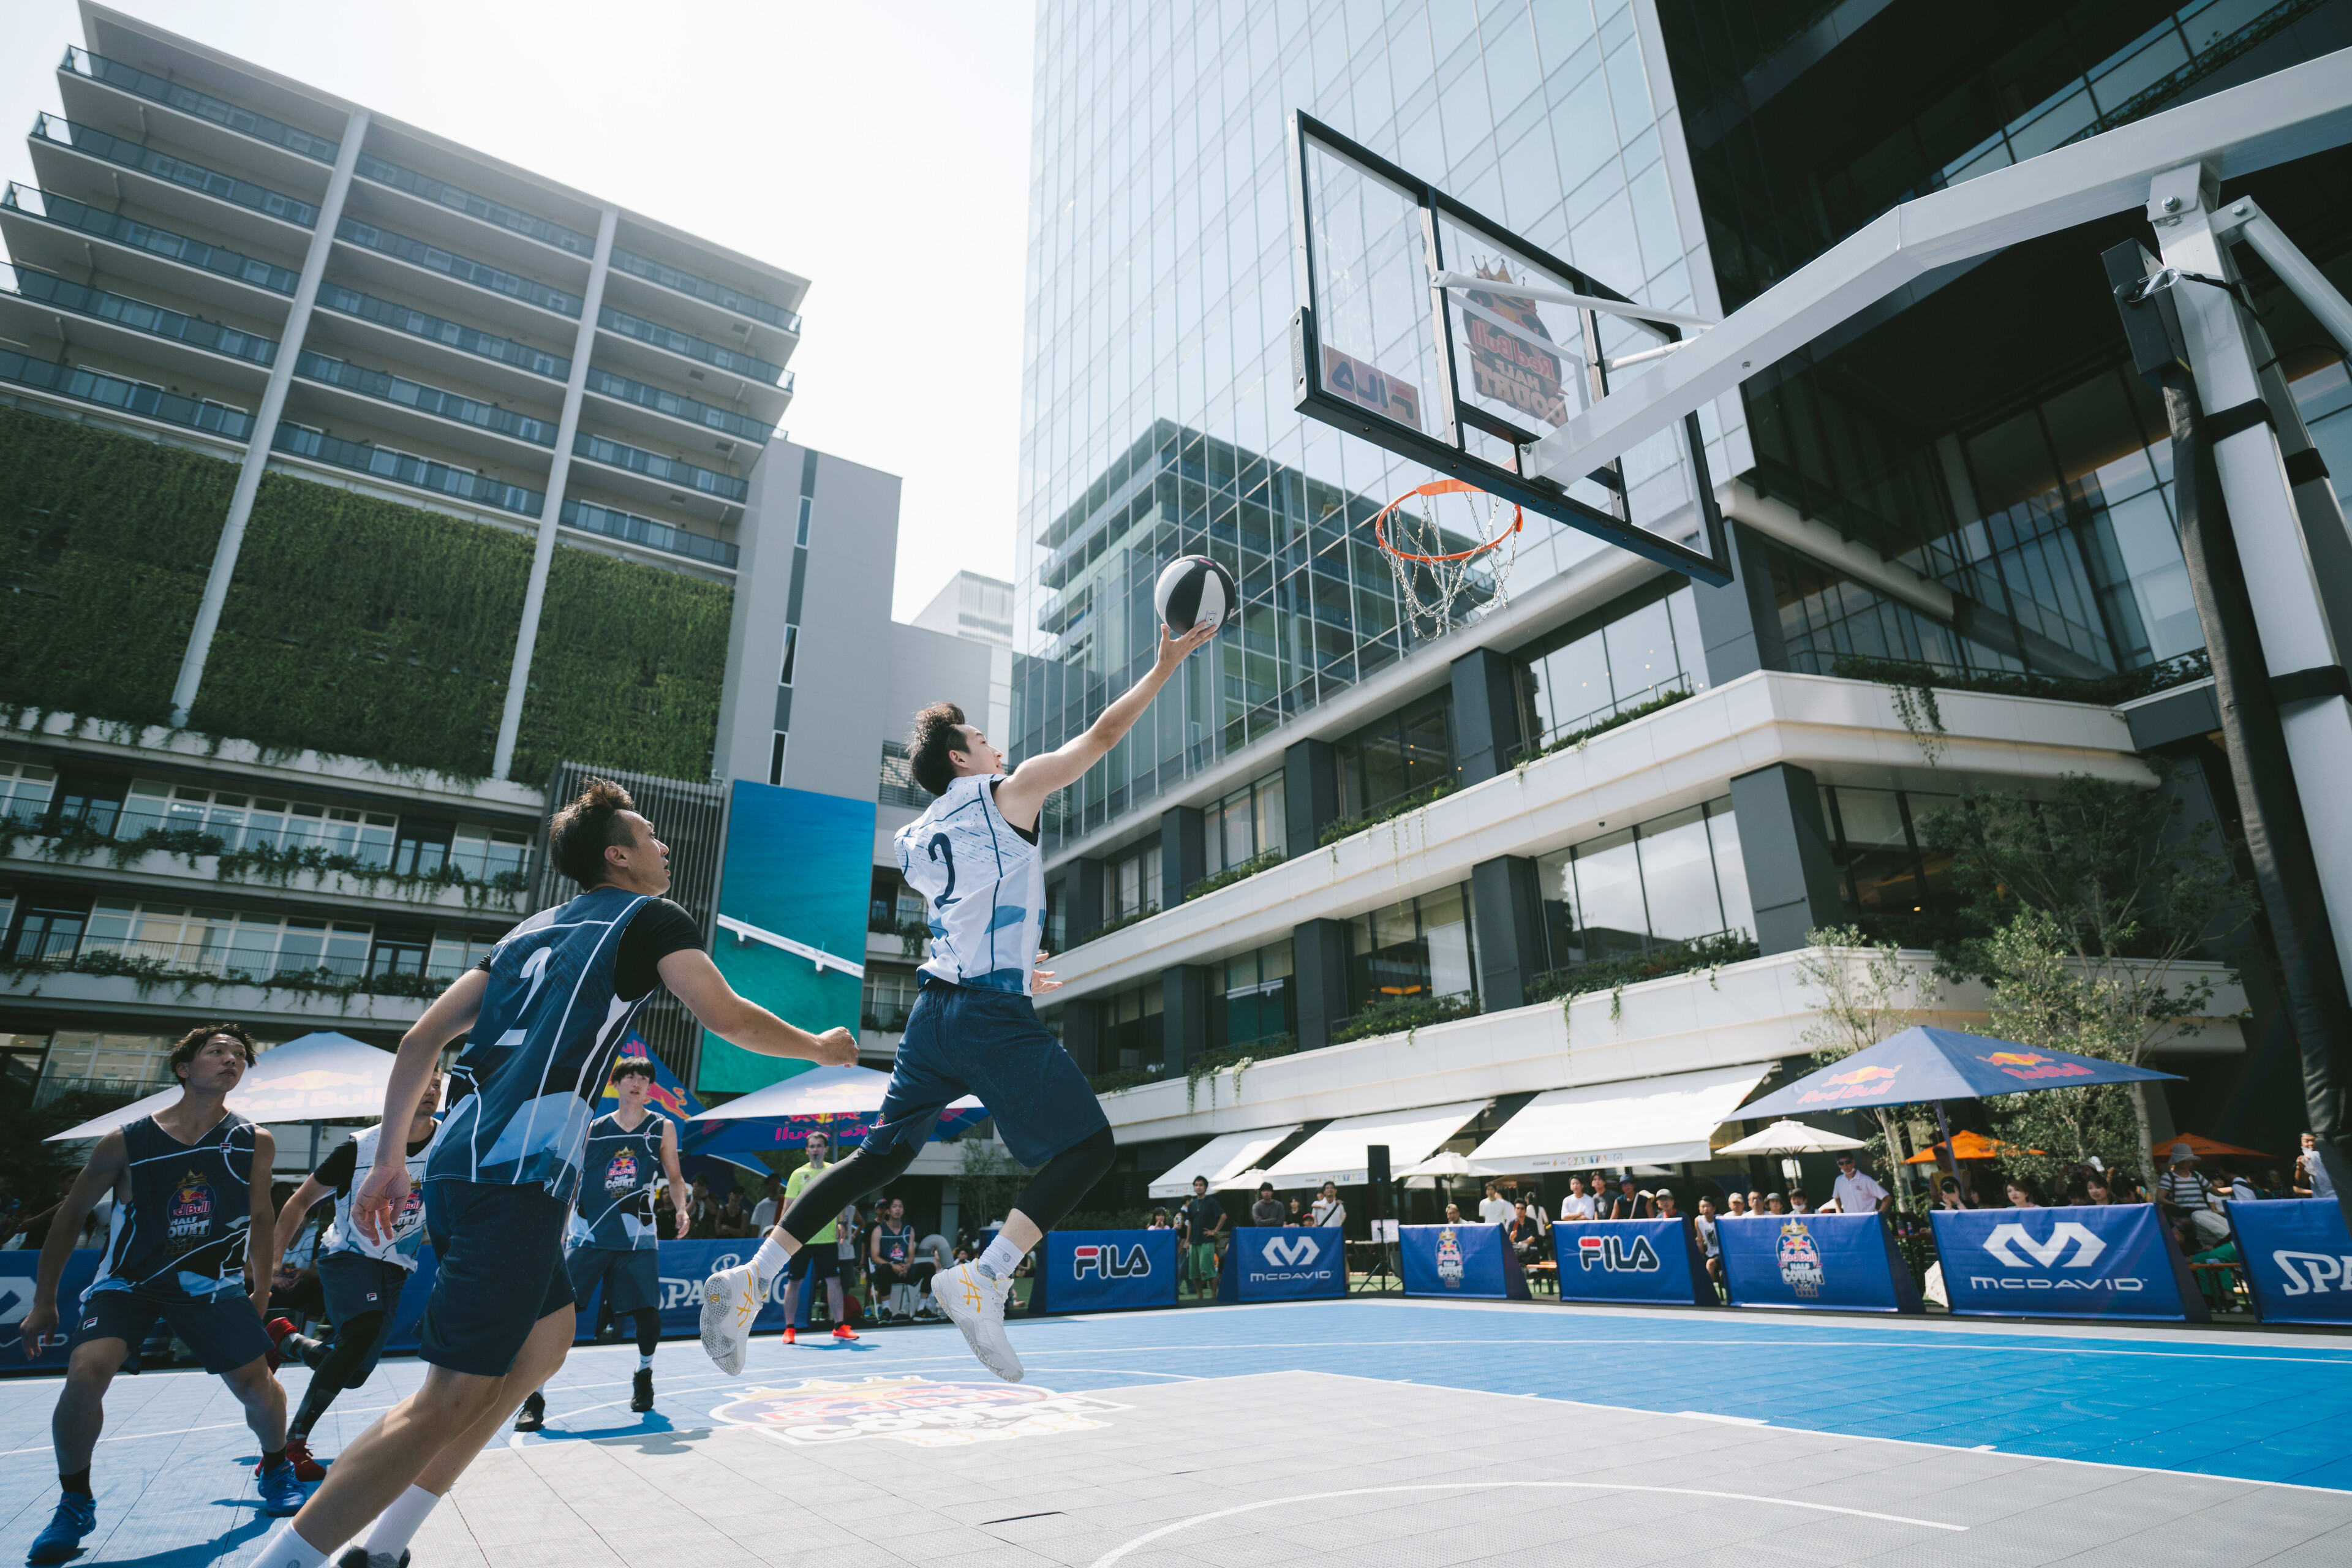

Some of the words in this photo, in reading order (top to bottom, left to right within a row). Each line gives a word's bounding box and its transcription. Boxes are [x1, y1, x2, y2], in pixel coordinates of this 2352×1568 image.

[1840, 1079, 1896, 1099] Bull
[186, 1200, 211, 1215] Bull
[167, 1218, 211, 1237] OURT
[1074, 1243, 1152, 1281] FILA
[1578, 1234, 1660, 1273] FILA
[1780, 1250, 1799, 1262] Red
[1798, 1250, 1819, 1262] Bull
[1782, 1267, 1824, 1284] COURT
[1790, 1262, 1811, 1270] HALF
[755, 1396, 909, 1421] Red
[892, 1389, 1030, 1408] Bull
